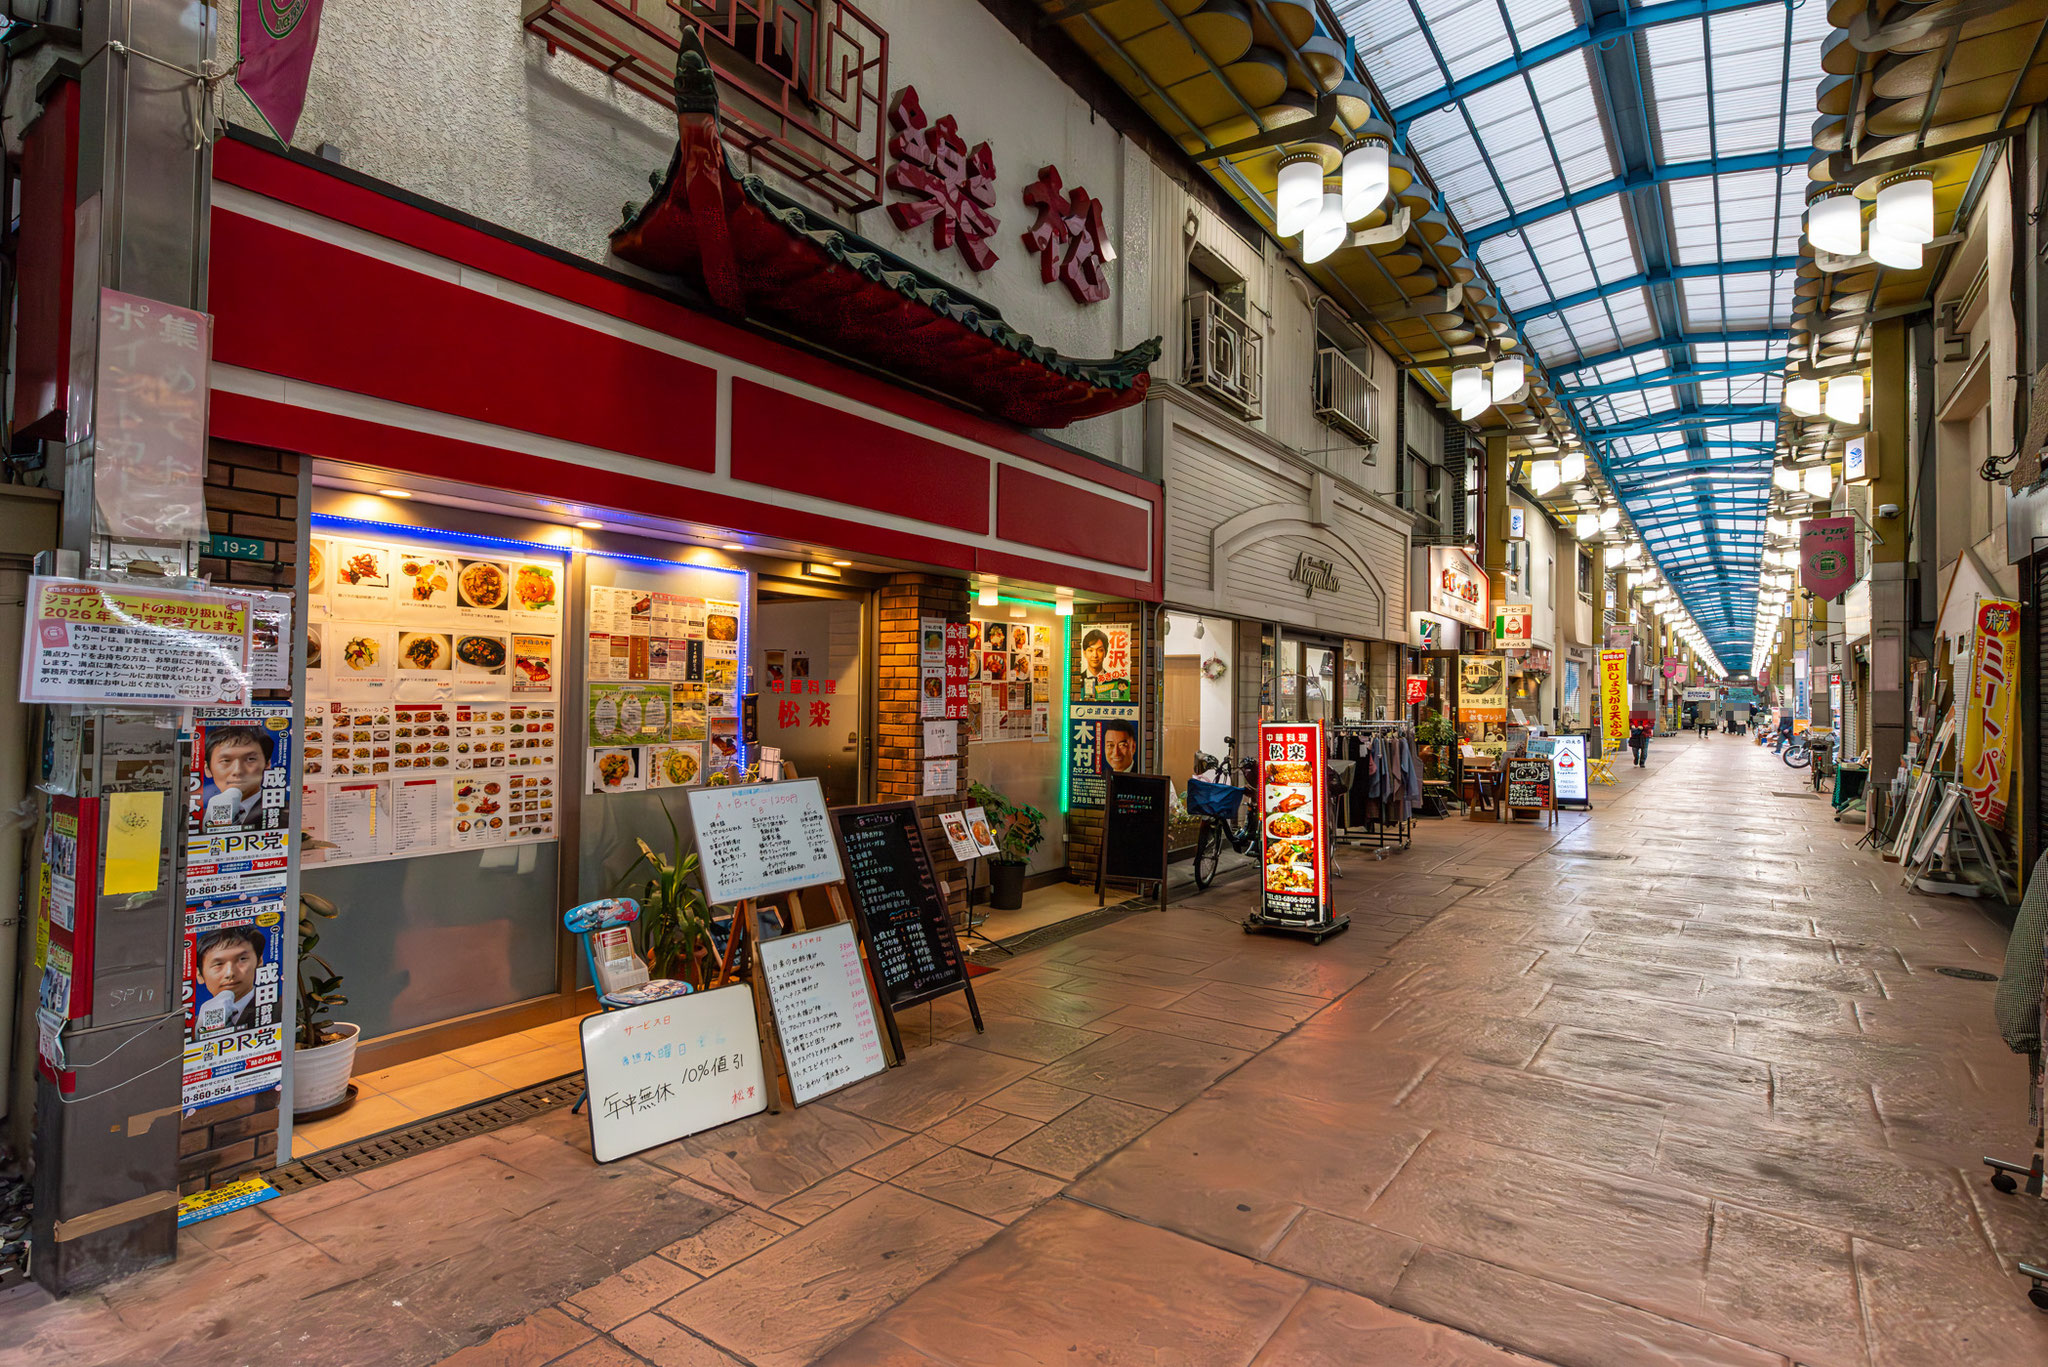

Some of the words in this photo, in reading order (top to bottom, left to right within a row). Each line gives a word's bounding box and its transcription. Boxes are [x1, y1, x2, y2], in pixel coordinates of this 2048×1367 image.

[221, 541, 259, 556] 19-2
[1108, 630, 1128, 668] 花沢
[778, 699, 831, 729] 松楽
[1607, 662, 1622, 738] 紅しょうがの天ぷら
[1073, 721, 1095, 767] 木村
[1269, 743, 1306, 760] 松楽
[624, 1015, 671, 1036] サービス日
[603, 1082, 675, 1120] 年中無休
